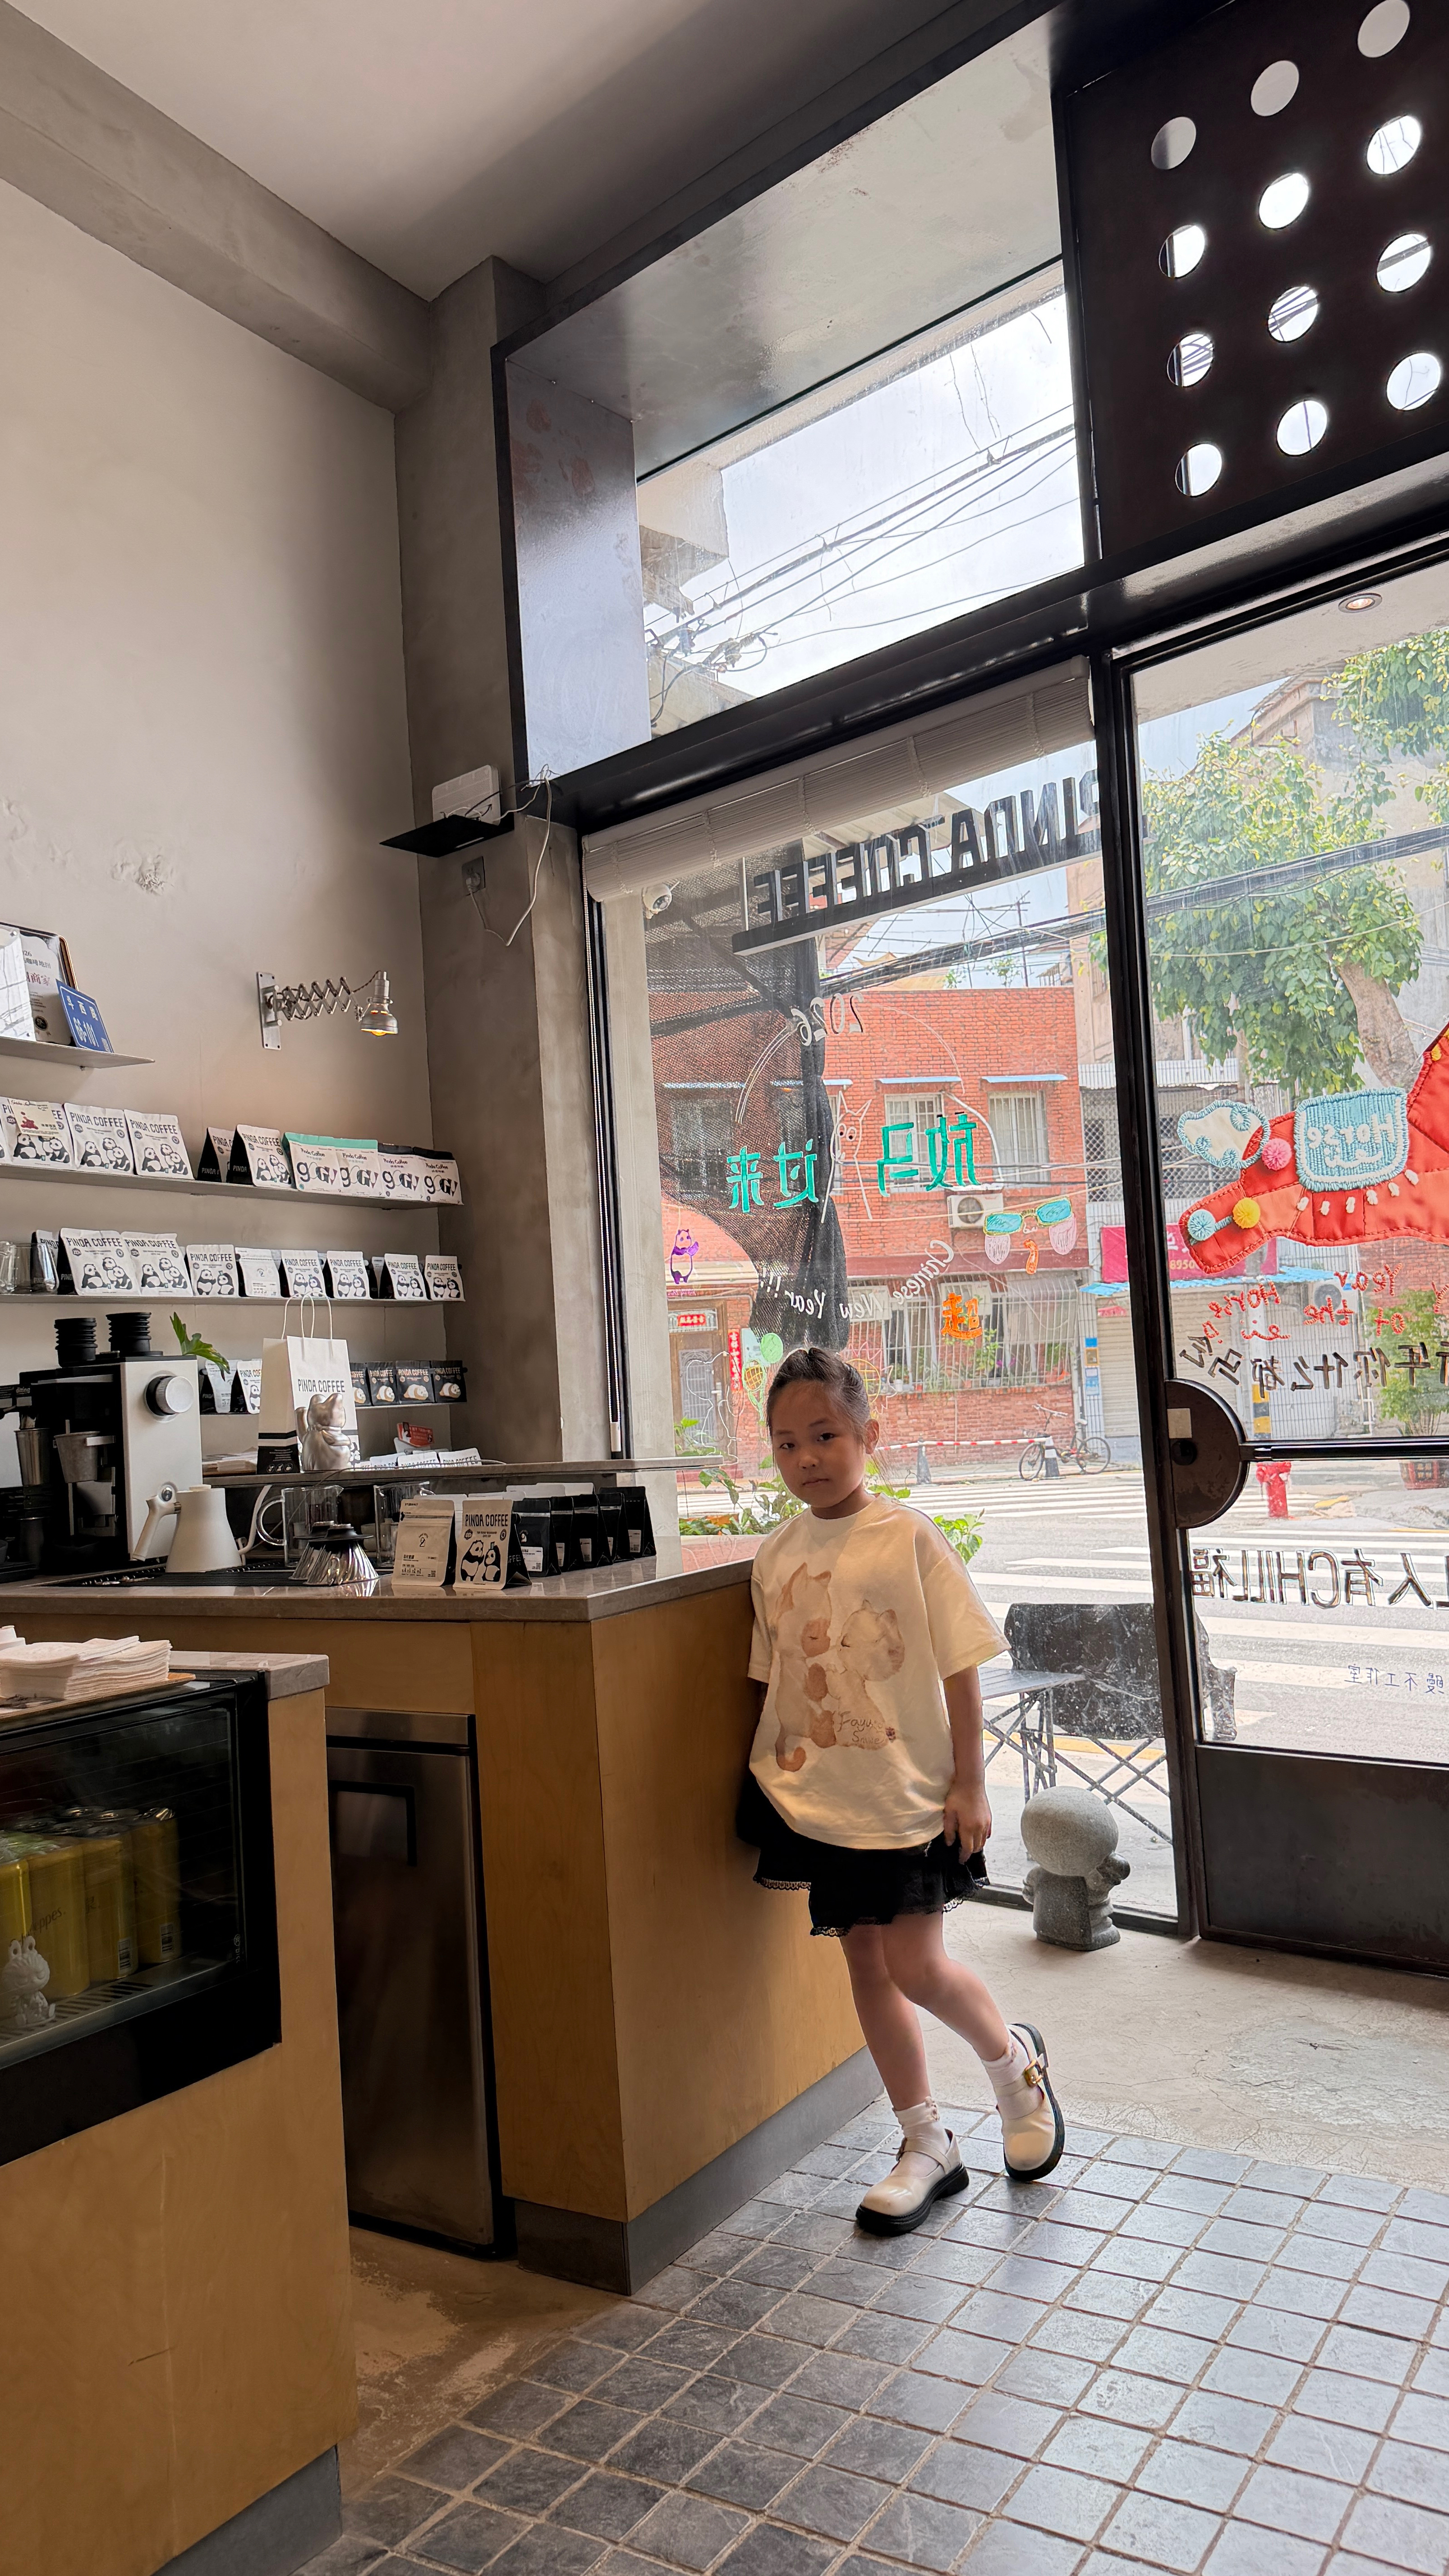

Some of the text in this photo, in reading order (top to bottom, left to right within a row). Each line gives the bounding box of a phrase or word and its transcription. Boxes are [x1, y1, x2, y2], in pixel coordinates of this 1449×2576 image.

[73, 1017, 100, 1047] 66-101
[70, 1112, 92, 1124] PINDA
[93, 1116, 124, 1128] COFFEE
[130, 1119, 178, 1134] PINDA COFFEE
[258, 1136, 281, 1147] COFFEE
[66, 1237, 123, 1247] PINDA COFFEE
[125, 1239, 177, 1249] PINDA COFFEE
[190, 1253, 233, 1262] PINDA COFFEE
[298, 1379, 345, 1393] PINDA COFFEE
[465, 1513, 508, 1527] PINDA COFFEE
